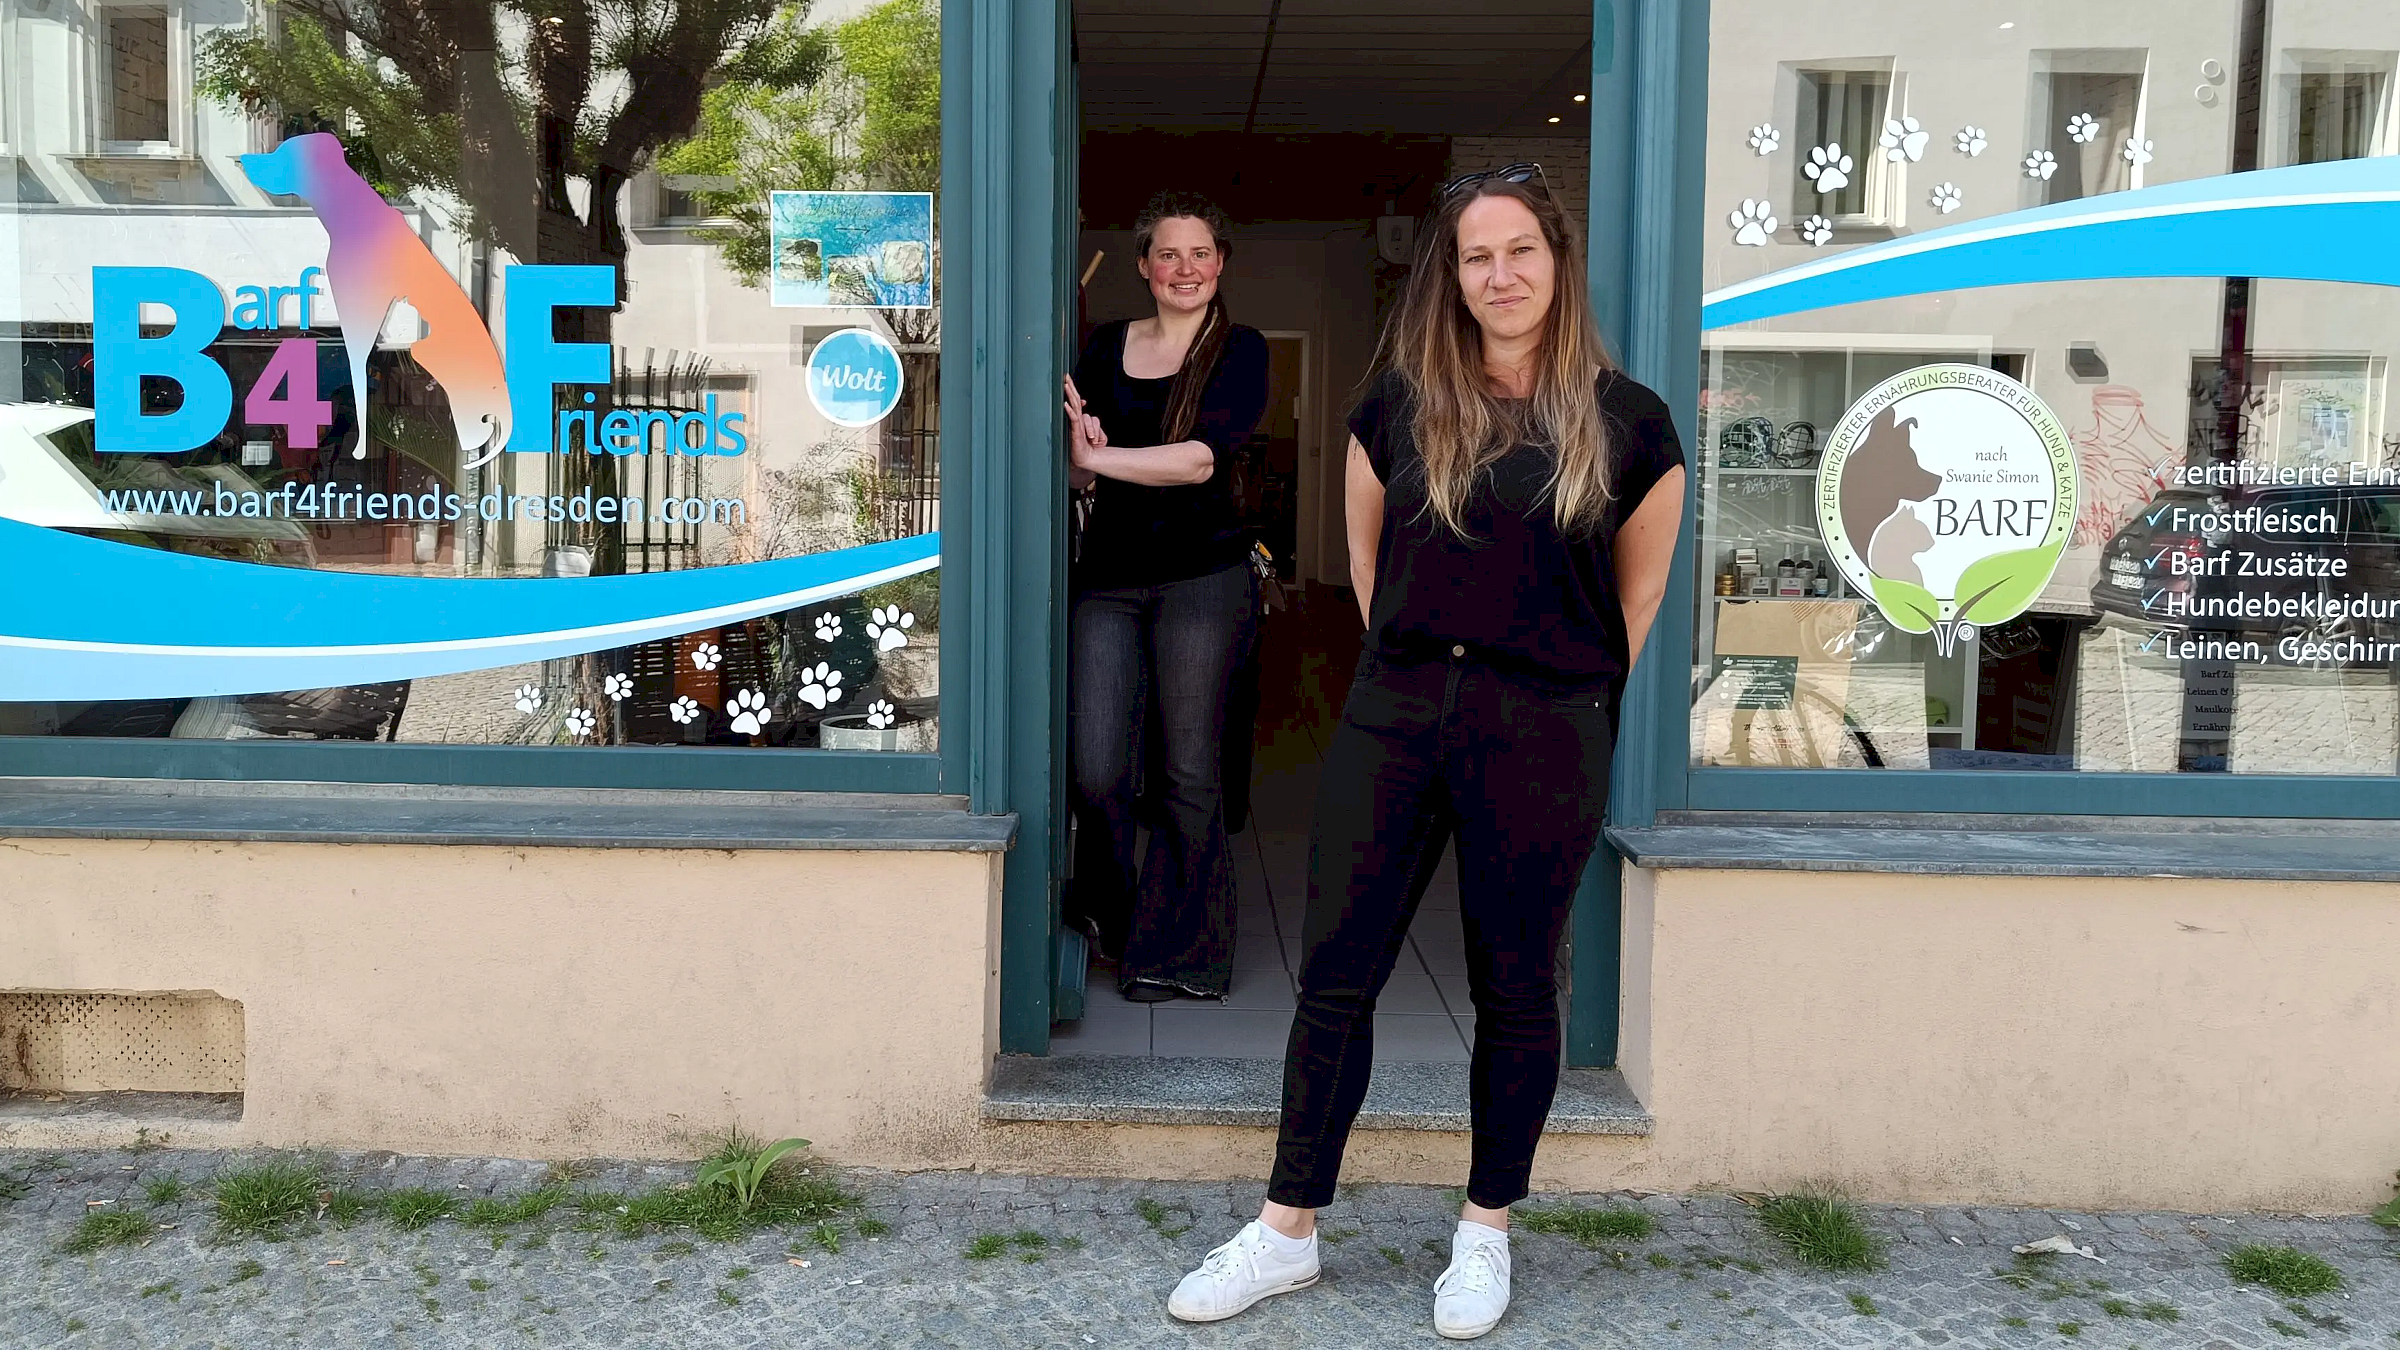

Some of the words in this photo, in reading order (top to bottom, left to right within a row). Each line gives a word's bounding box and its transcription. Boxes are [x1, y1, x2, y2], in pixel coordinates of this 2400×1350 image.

[92, 265, 321, 453] Barf
[244, 338, 333, 449] 4
[505, 264, 746, 457] Friends
[822, 364, 886, 393] Wolt
[1867, 371, 2018, 416] ERNÄHRUNGSBERATER
[2016, 395, 2041, 421] FÜR
[2037, 418, 2066, 459] HUND
[1823, 411, 1868, 510] ZERTIFIZIERTER
[1975, 446, 2008, 462] nach
[2057, 462, 2069, 473] &
[1945, 468, 1993, 484] Swanie
[1996, 468, 2040, 484] Simon
[2173, 459, 2338, 486] zertifizierte
[2348, 460, 2400, 486] Ern
[97, 480, 746, 523] www.barf4friends-dresden.com
[2057, 476, 2072, 519] KATZE
[1933, 499, 2048, 537] BARF
[2172, 507, 2337, 533] Frostfleisch
[2170, 549, 2232, 577] Barf
[2237, 551, 2348, 577] Zusätze
[2165, 634, 2268, 664] Leinen,
[2201, 670, 2221, 679] Barf
[2186, 687, 2218, 696] Leinen
